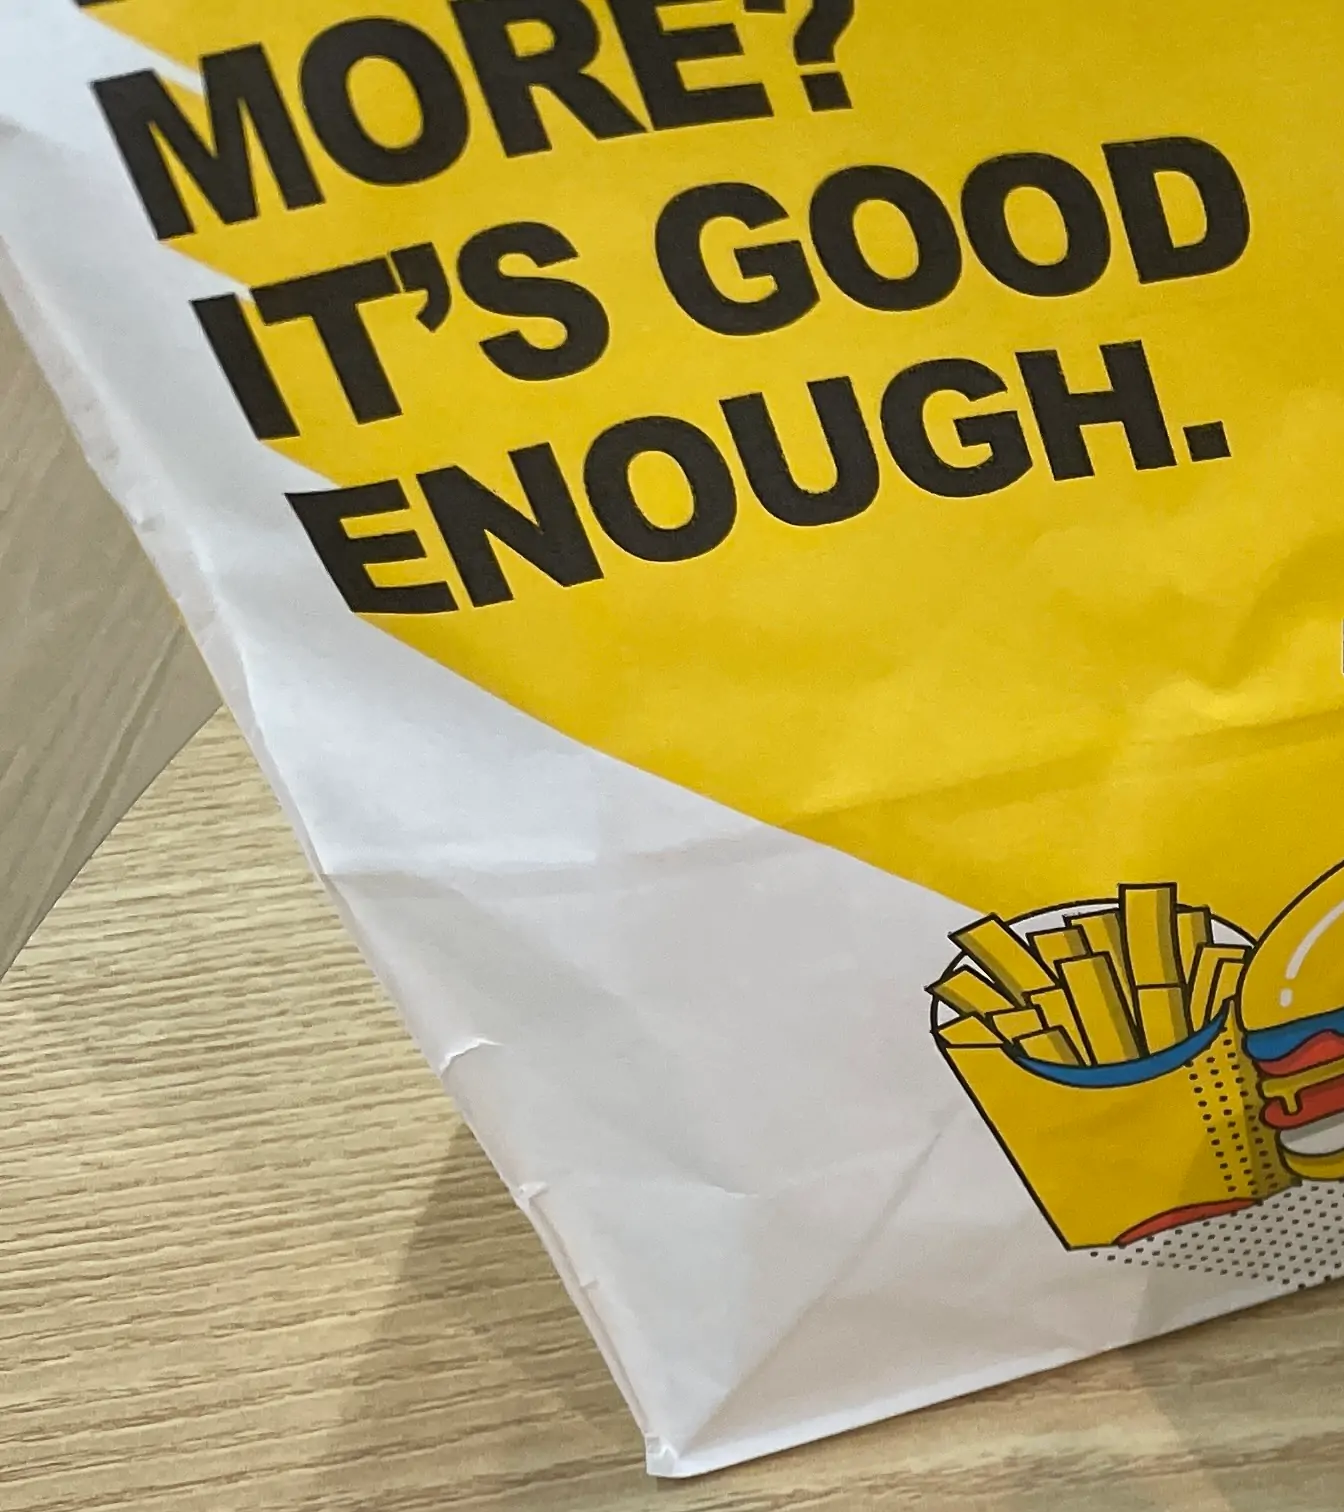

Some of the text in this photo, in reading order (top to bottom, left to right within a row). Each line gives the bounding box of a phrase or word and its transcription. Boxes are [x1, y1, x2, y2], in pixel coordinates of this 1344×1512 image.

[90, 0, 854, 240] MORE?
[191, 135, 1250, 440] IT'S GOOD
[284, 340, 1231, 615] ENOUGH.
